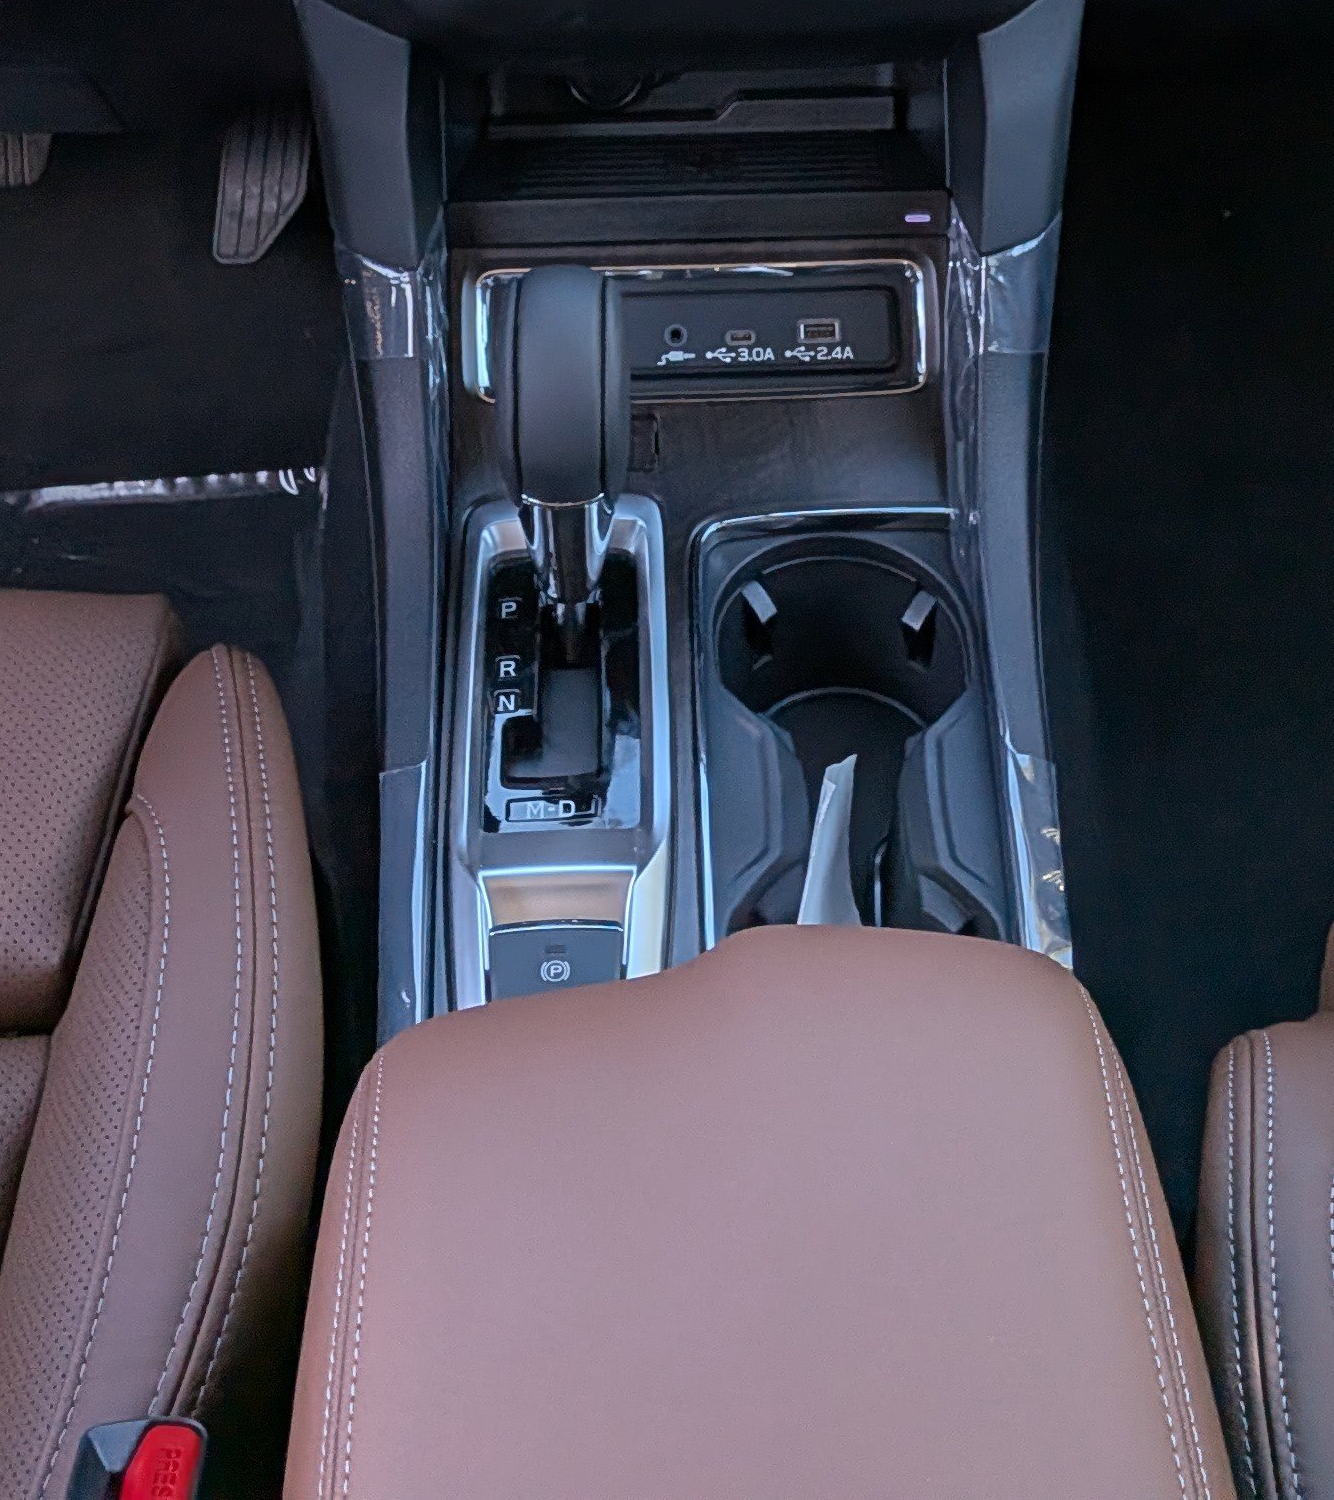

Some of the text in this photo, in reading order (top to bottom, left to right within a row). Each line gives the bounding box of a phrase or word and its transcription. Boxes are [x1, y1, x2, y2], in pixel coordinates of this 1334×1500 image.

[737, 346, 776, 362] 3.0A
[816, 346, 855, 361] 2.4A
[500, 601, 517, 619] P
[499, 660, 517, 678] R
[498, 694, 516, 711] N
